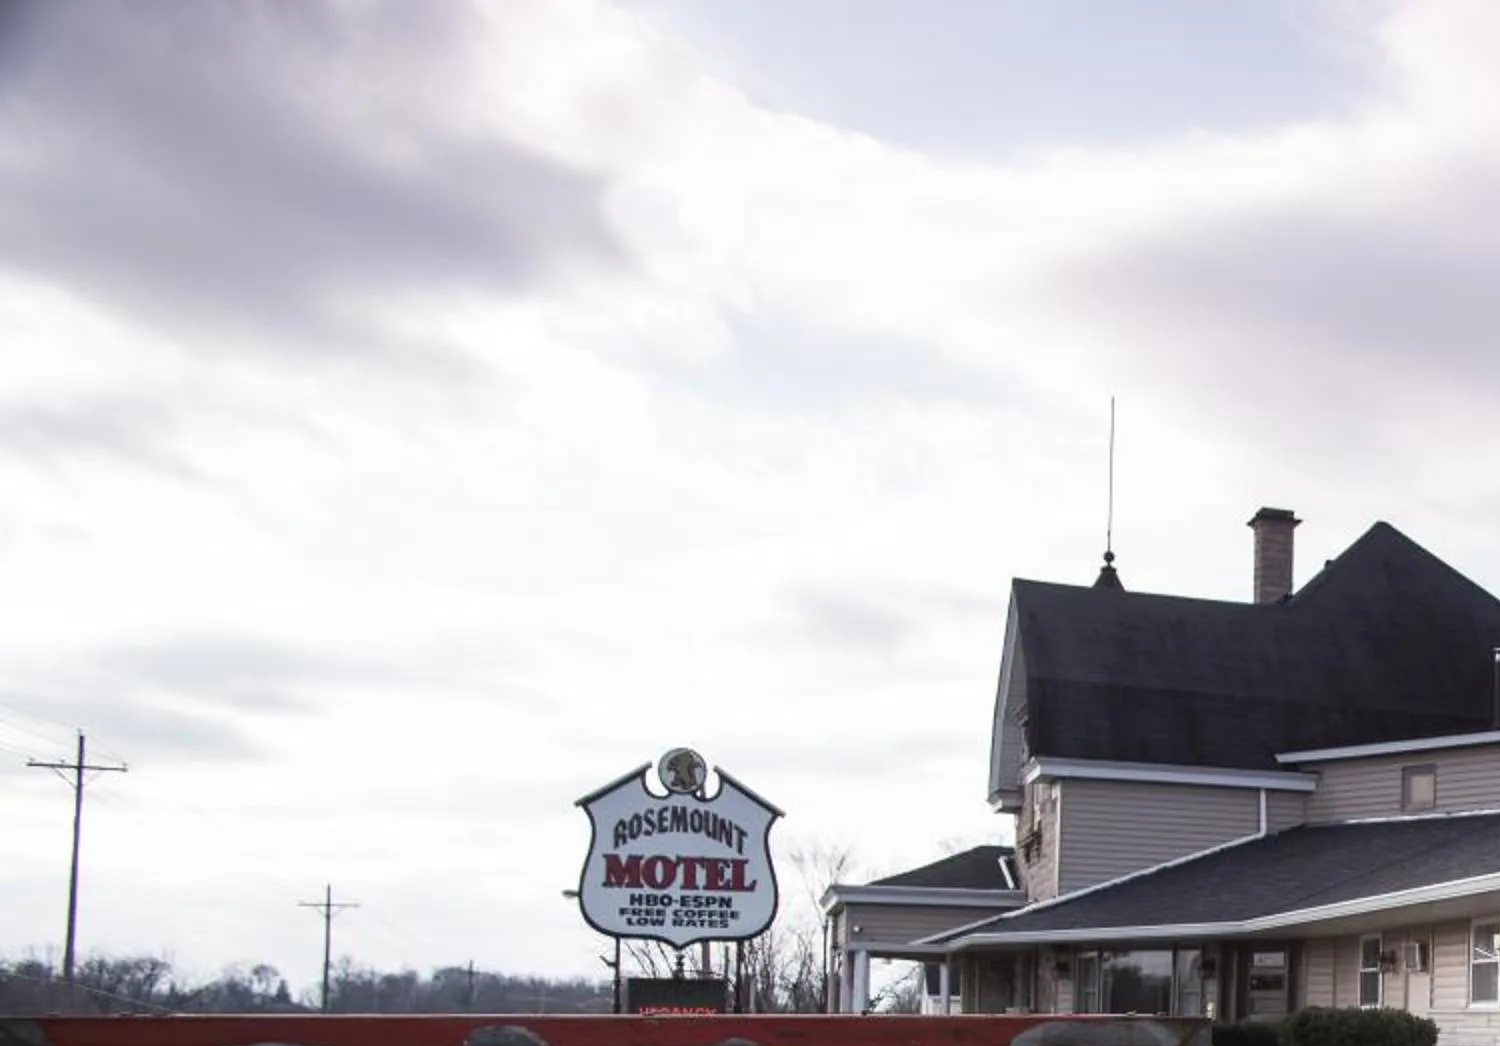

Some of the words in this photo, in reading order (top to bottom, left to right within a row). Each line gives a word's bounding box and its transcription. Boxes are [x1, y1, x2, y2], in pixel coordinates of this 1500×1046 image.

[614, 805, 748, 854] ROSEMOUNT
[602, 853, 757, 893] MOTEL
[629, 893, 732, 909] HBO-ESPN
[618, 907, 667, 917] FREE
[672, 909, 740, 920] COFFEE
[626, 917, 666, 927] LOW
[671, 918, 729, 929] RATES
